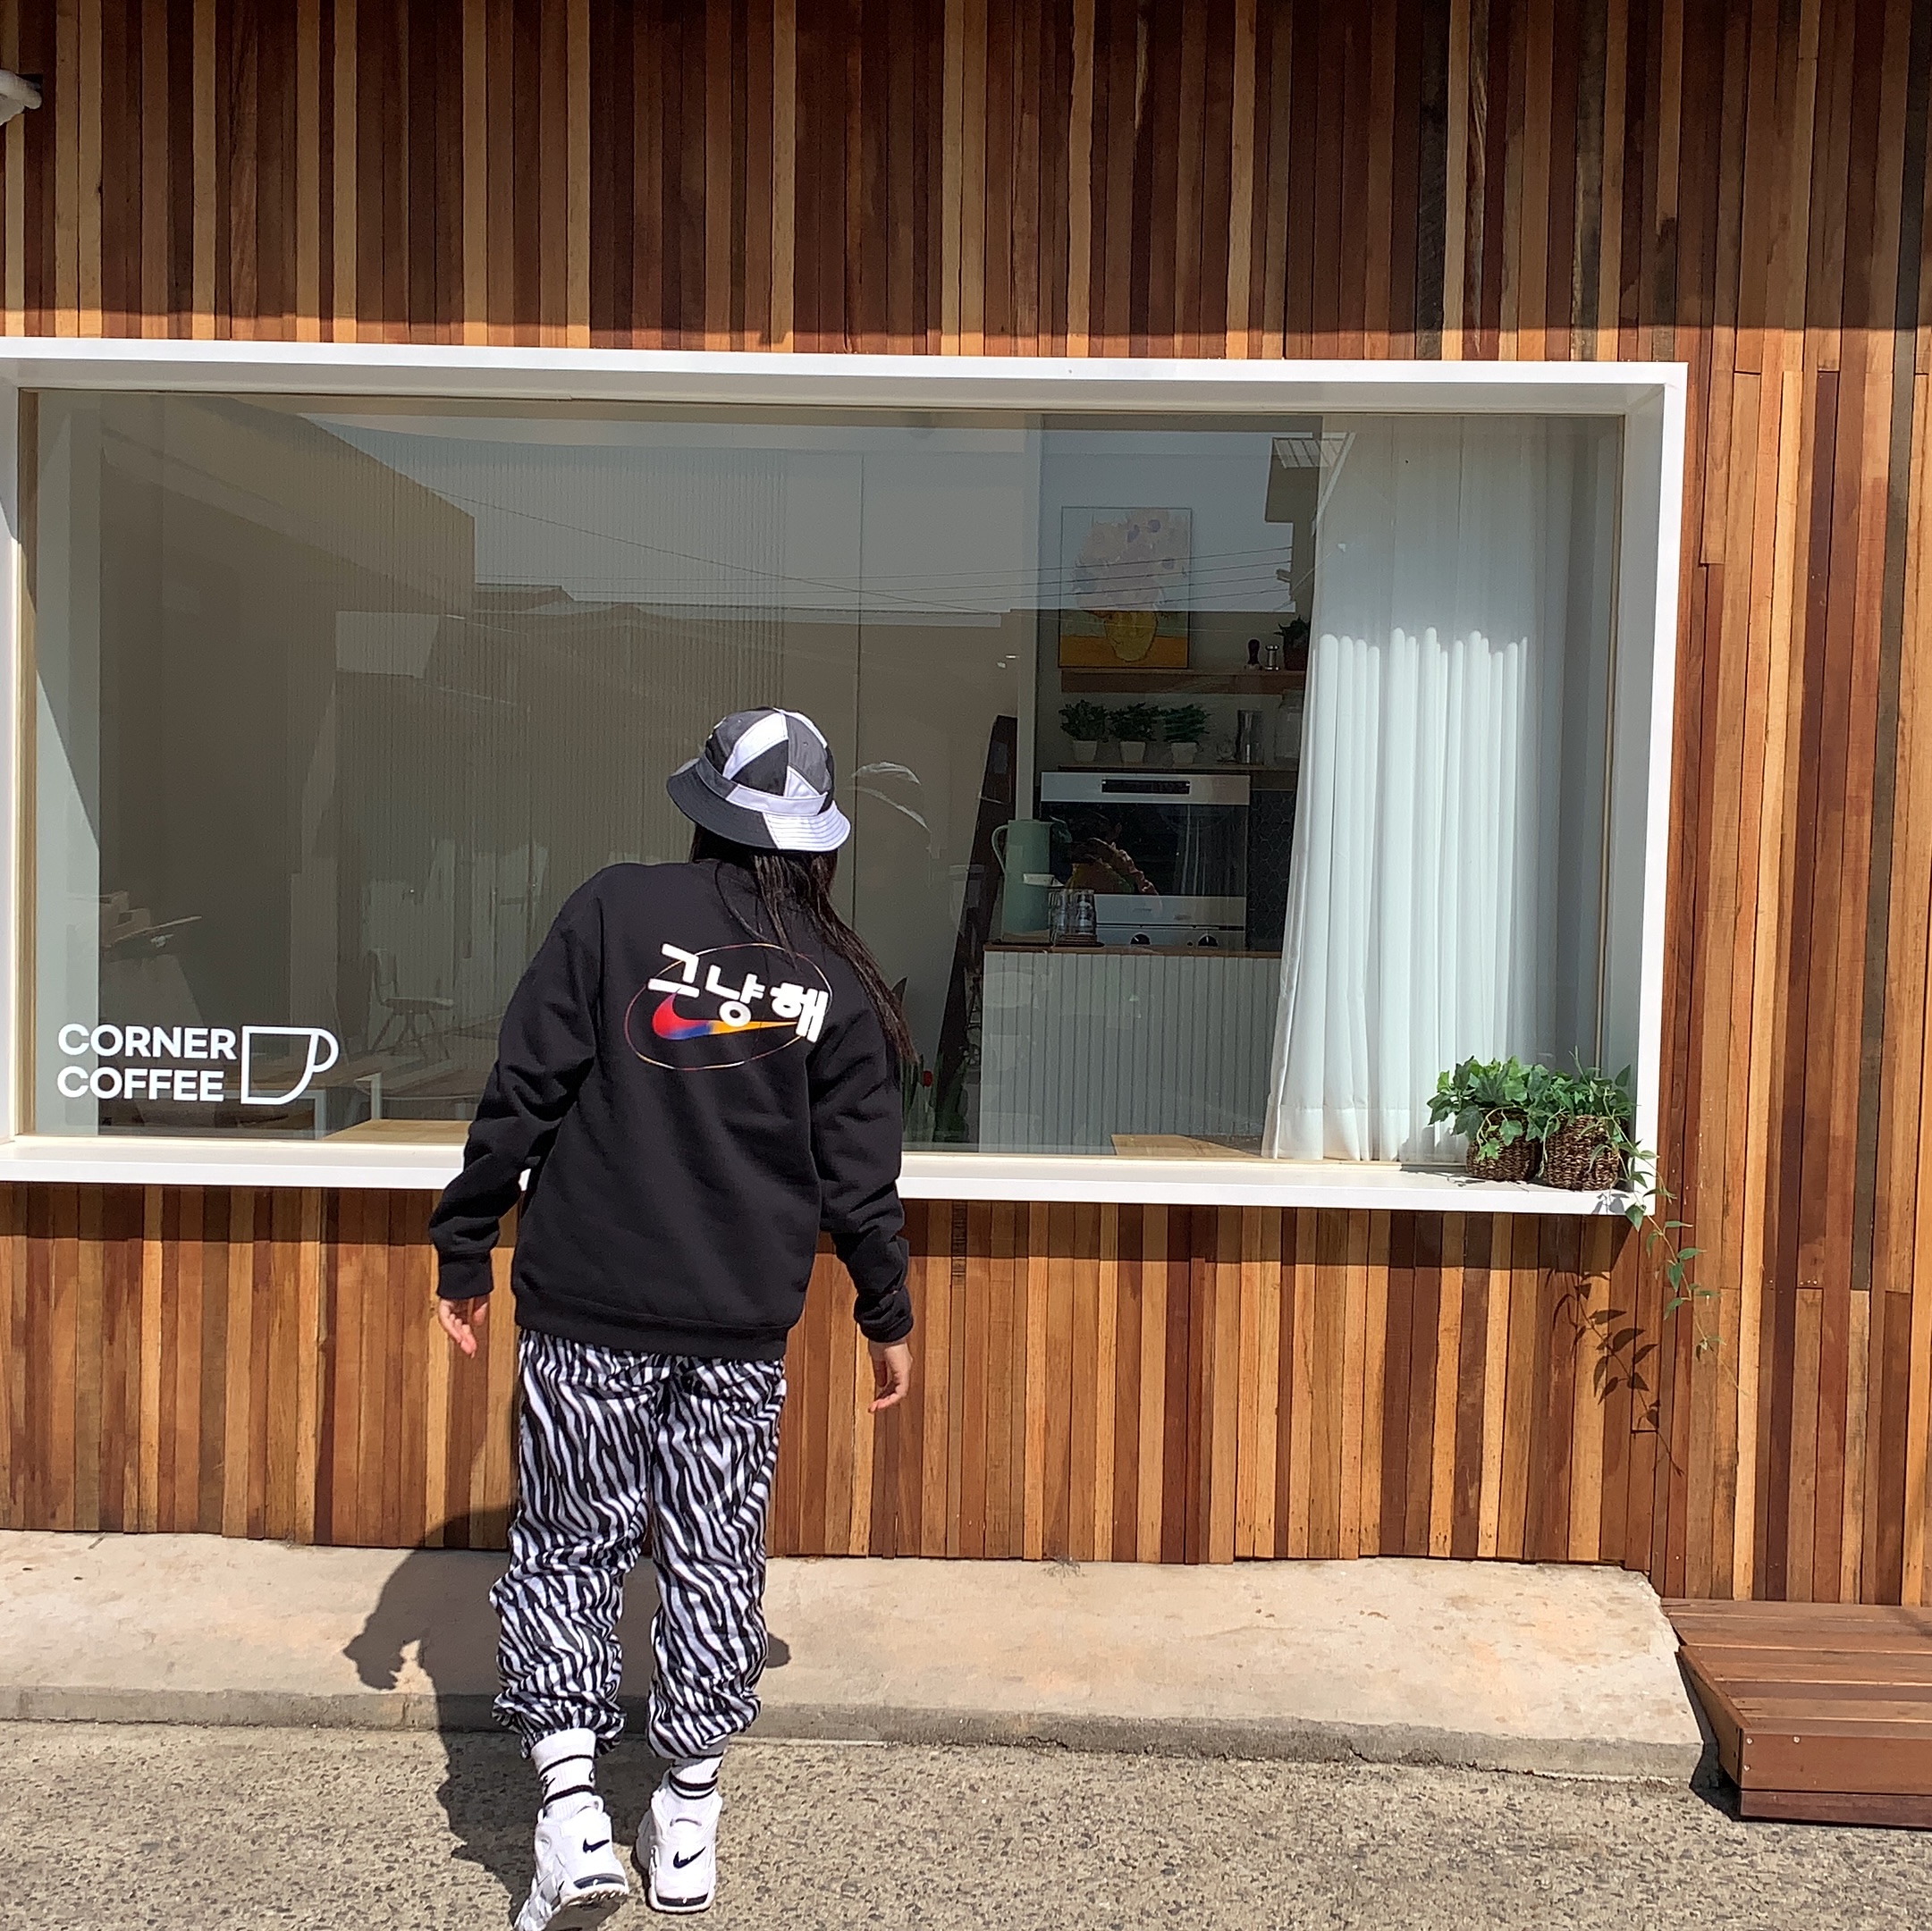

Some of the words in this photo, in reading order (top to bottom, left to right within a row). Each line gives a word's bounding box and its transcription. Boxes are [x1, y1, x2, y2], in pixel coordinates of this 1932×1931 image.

[647, 943, 829, 1042] 그냥해
[58, 1023, 237, 1060] CORNER
[56, 1066, 224, 1101] COFFEE
